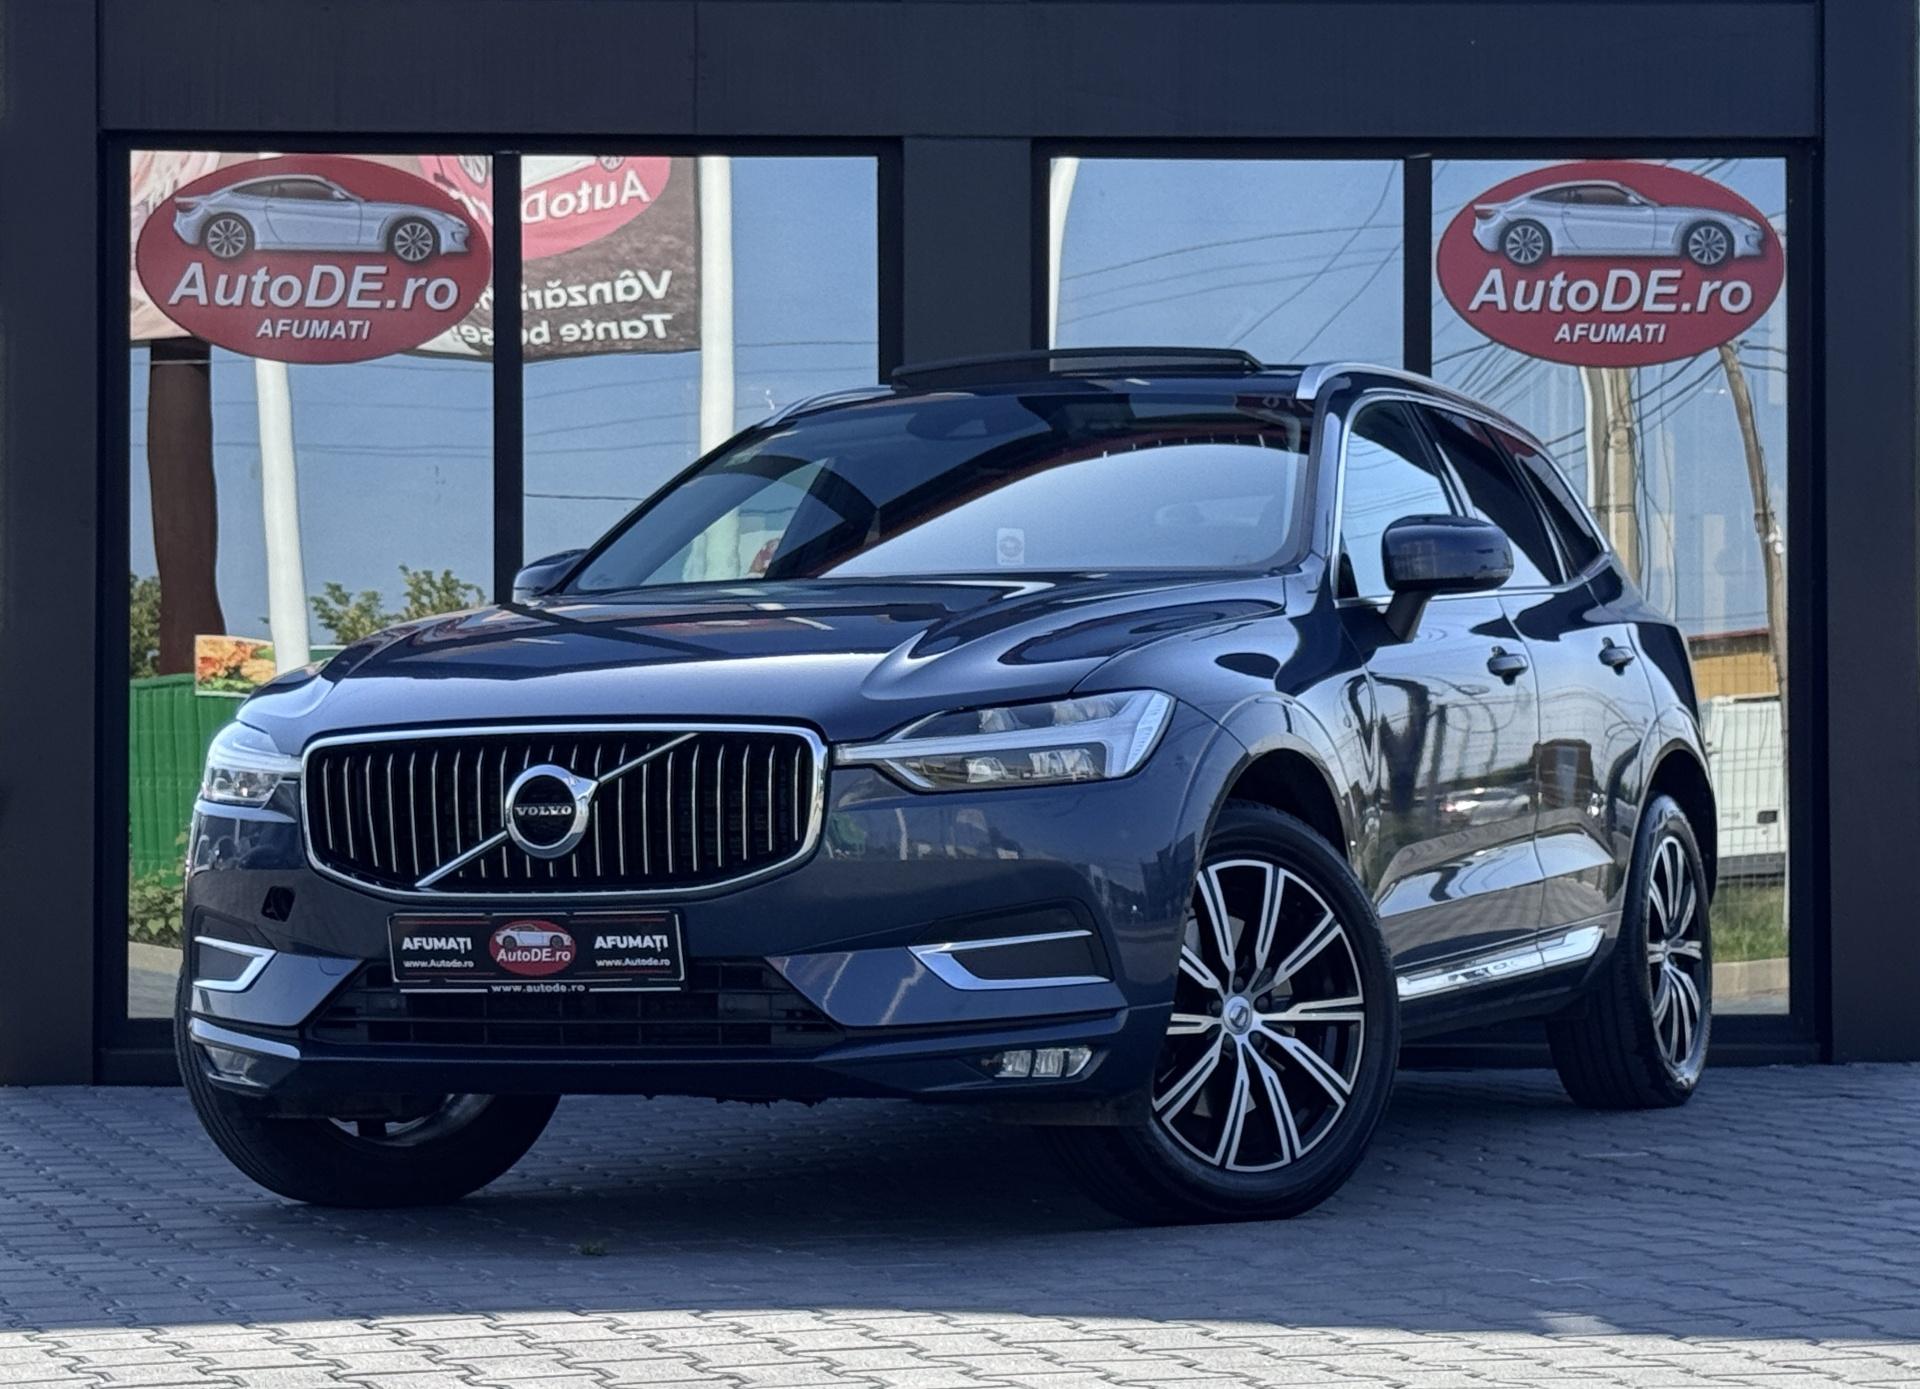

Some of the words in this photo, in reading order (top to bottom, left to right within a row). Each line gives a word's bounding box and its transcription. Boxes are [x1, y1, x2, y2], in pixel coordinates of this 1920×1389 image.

[168, 262, 459, 310] AutoDE.ro
[1467, 267, 1754, 314] AutoDE.ro
[255, 318, 371, 340] AFUMATI
[1553, 323, 1667, 343] AFUMATI
[514, 805, 573, 816] VOLVO
[496, 948, 571, 963] AutoDE.ro
[595, 956, 671, 967] www.Autode.ro
[403, 958, 474, 969] www.Autode.ro
[490, 983, 586, 993] www.autode.ro
